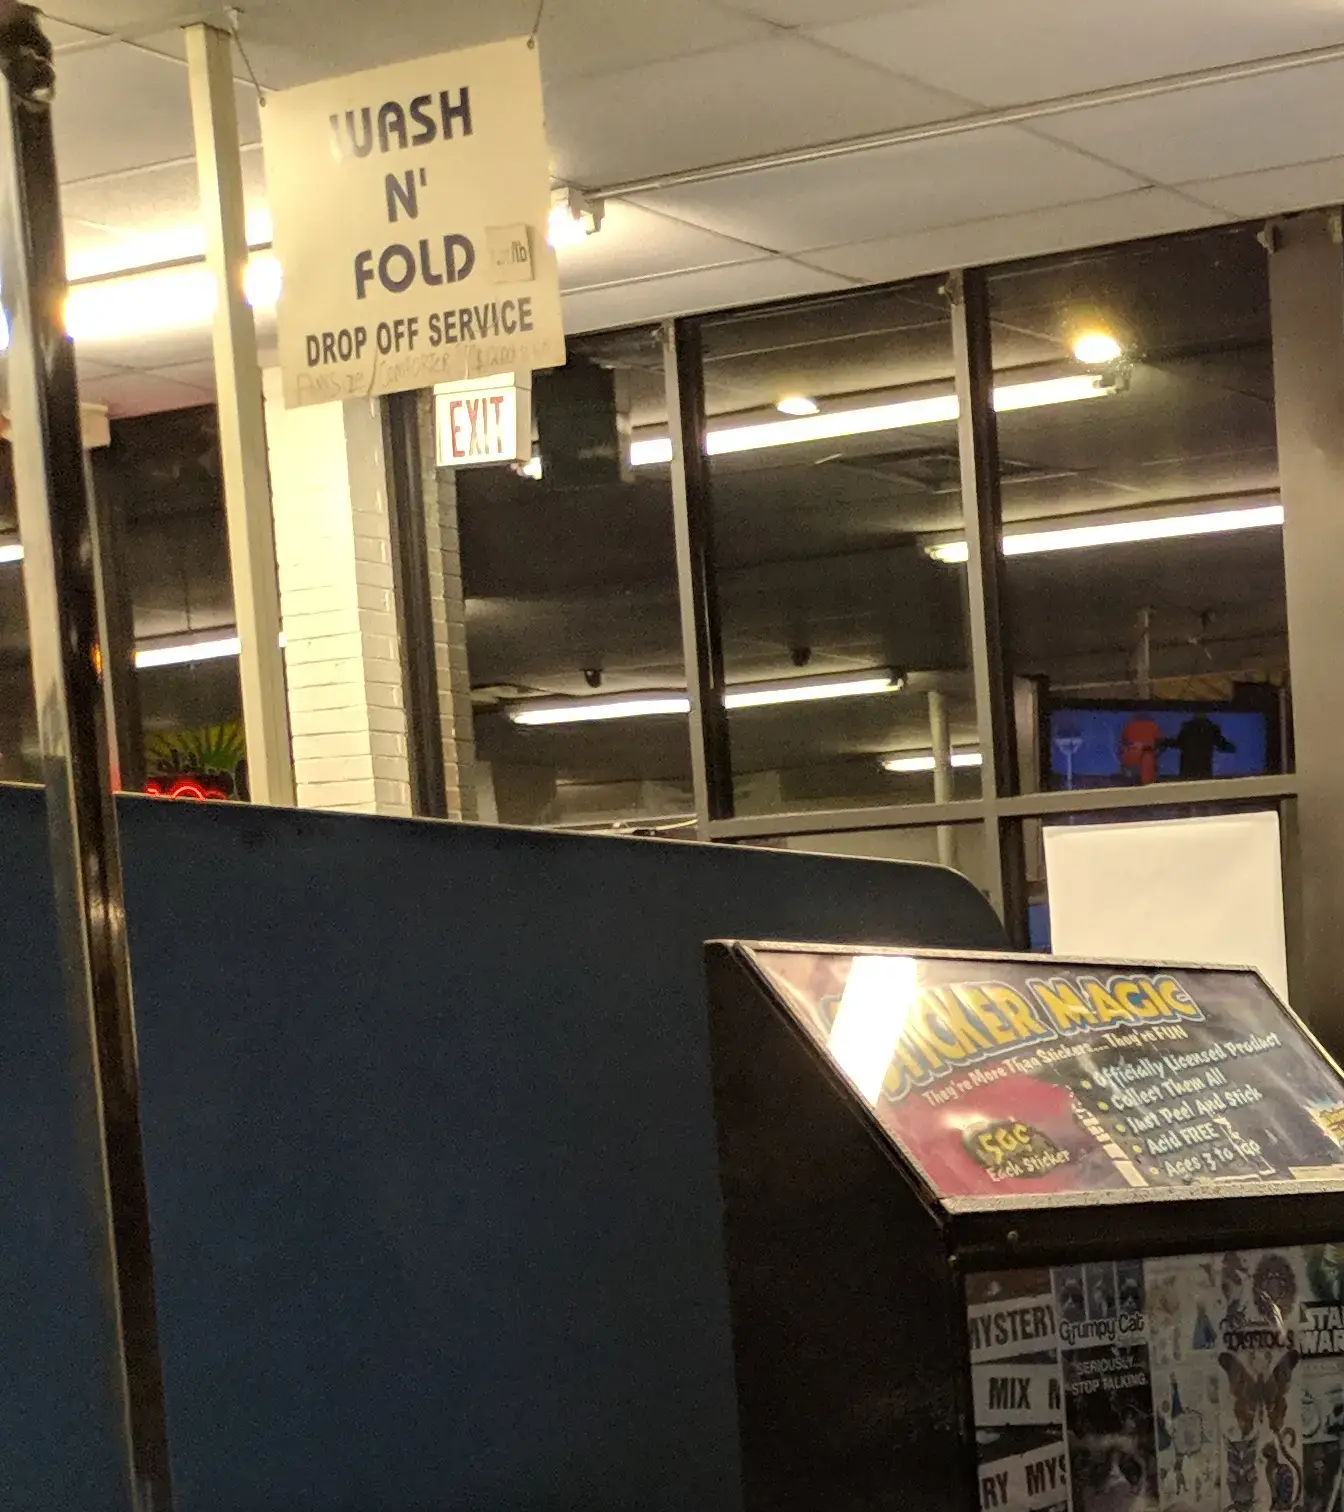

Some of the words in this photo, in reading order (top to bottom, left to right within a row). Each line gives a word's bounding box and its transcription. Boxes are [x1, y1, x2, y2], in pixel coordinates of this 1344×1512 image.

[329, 86, 473, 162] WASH
[385, 168, 428, 223] N'
[354, 233, 476, 299] FOLD
[305, 326, 368, 368] DROP
[376, 316, 420, 356] OFF
[428, 297, 534, 347] SERVICE
[451, 395, 506, 460] EXIT
[1026, 974, 1206, 1036] MAGIC
[921, 1080, 973, 1106] They're
[969, 1066, 1007, 1088] More
[1005, 1056, 1042, 1074] Than
[1151, 1025, 1188, 1041] FUN
[1093, 1057, 1164, 1088] Officially
[1162, 1044, 1227, 1071] Licensed
[1224, 1032, 1281, 1056] Product
[1112, 1087, 1163, 1111] Collect
[1162, 1078, 1206, 1097] Them
[1204, 1067, 1227, 1087] All
[1126, 1112, 1160, 1134] Just
[1159, 1100, 1195, 1124] Peel
[1196, 1093, 1227, 1115] And
[1224, 1084, 1263, 1107] Stick
[1146, 1131, 1182, 1155] Acid
[1180, 1122, 1220, 1143] FREE
[1163, 1155, 1201, 1178] Ages
[1215, 1146, 1233, 1162] to
[986, 1160, 1024, 1182] Each
[1022, 1148, 1070, 1172] Sticker
[1060, 1320, 1115, 1345] Grumpy
[1119, 1311, 1144, 1333] Cat
[989, 1377, 1031, 1409] MIX
[1071, 1380, 1100, 1396] STOP
[981, 1470, 1008, 1510] RY
